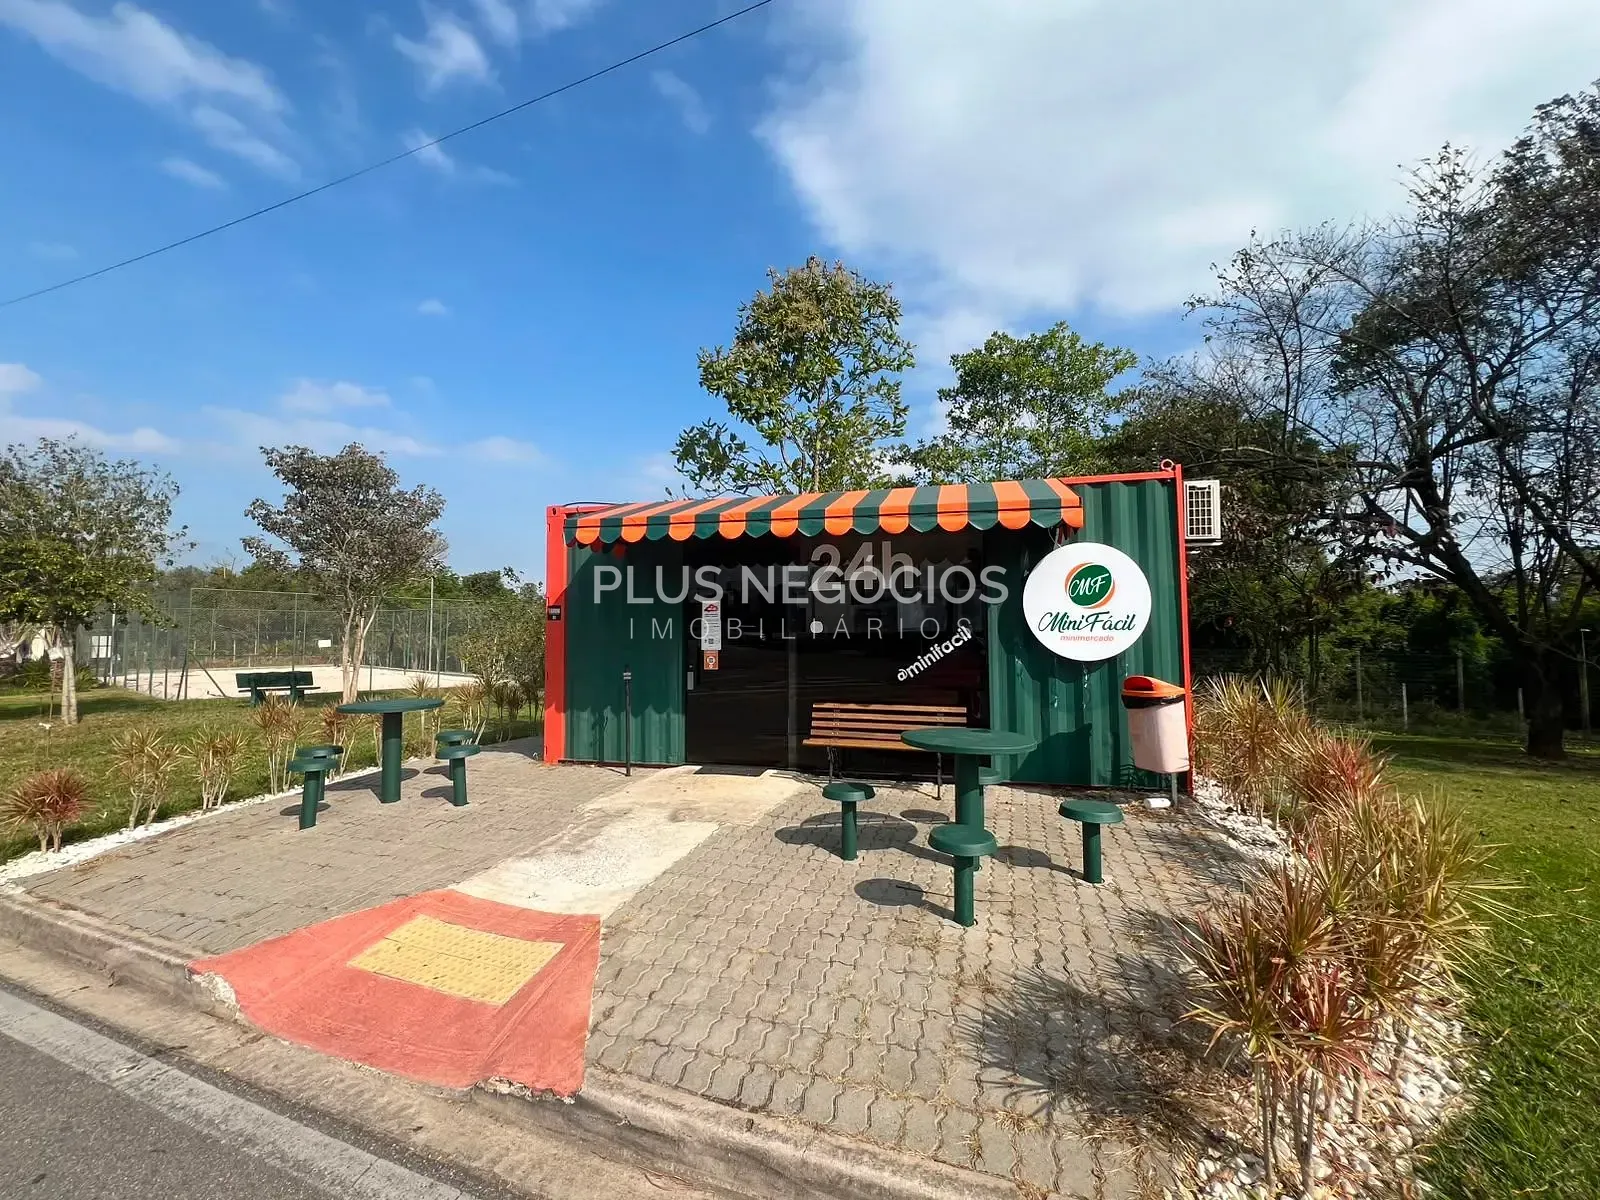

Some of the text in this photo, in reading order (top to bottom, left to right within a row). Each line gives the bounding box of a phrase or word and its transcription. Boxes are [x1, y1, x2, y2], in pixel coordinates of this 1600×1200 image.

[808, 541, 915, 592] 24h
[1069, 573, 1110, 598] MF
[896, 625, 973, 683] @minifacil
[1060, 634, 1114, 643] minimercado
